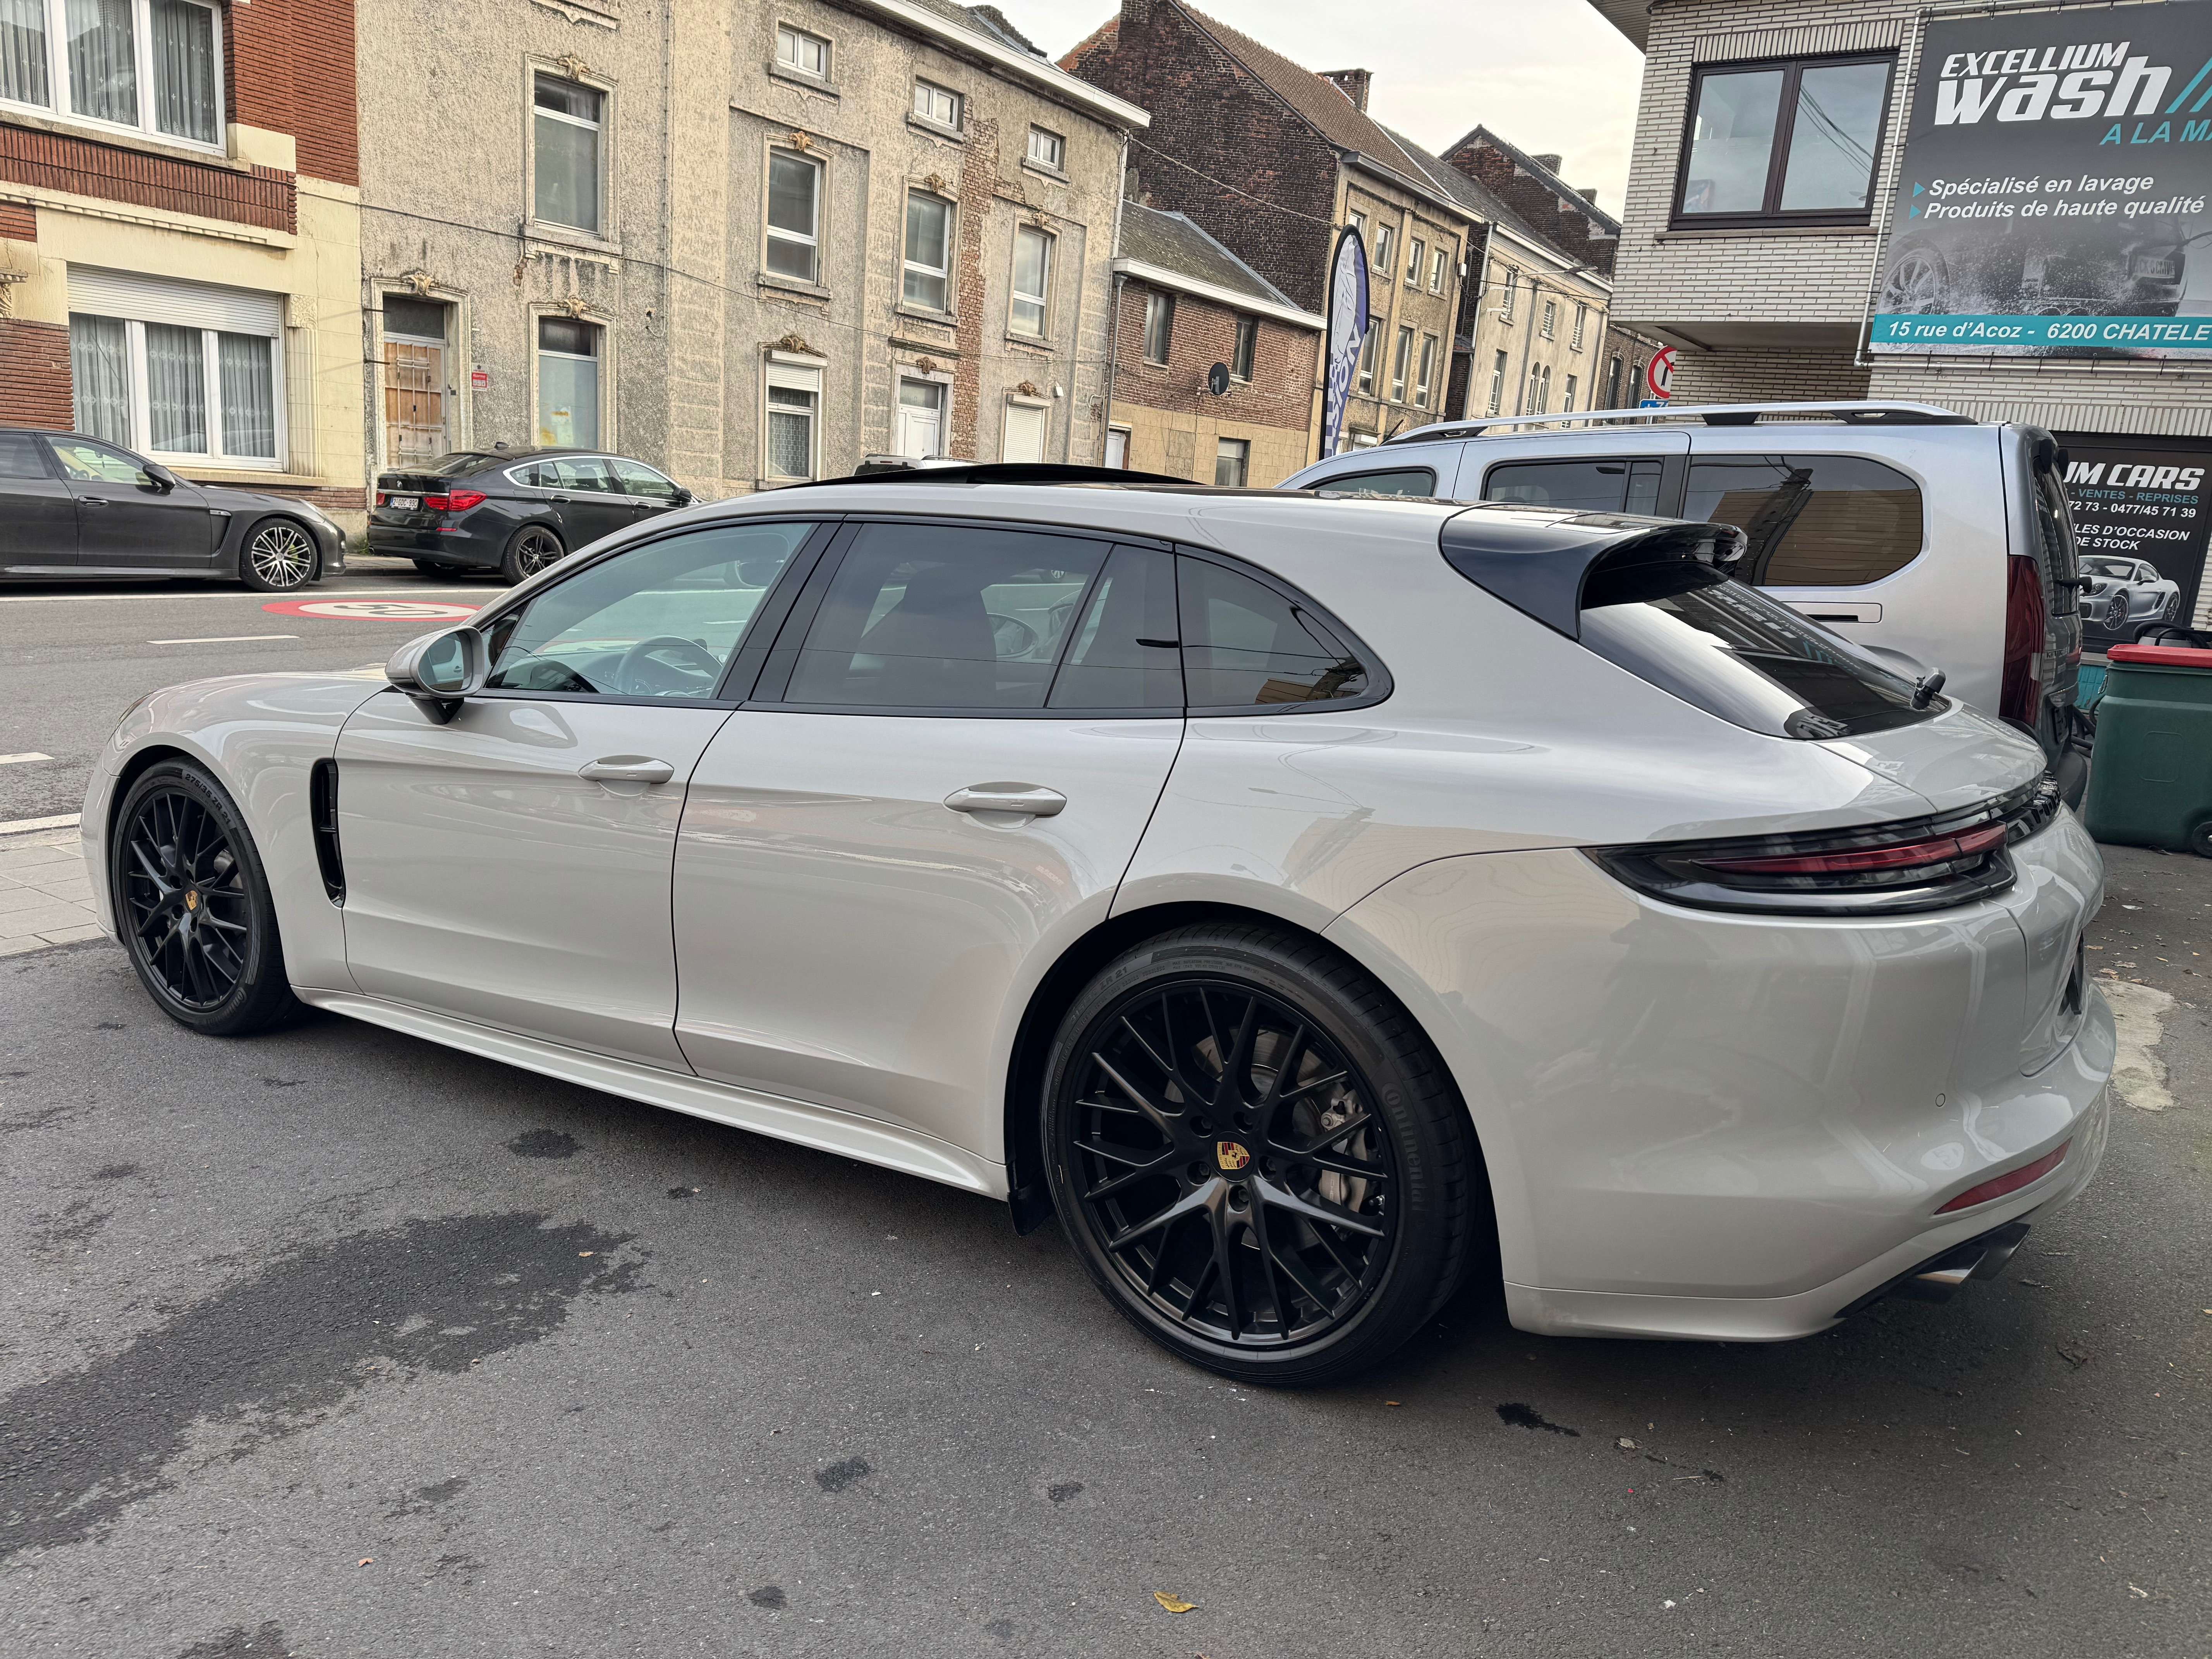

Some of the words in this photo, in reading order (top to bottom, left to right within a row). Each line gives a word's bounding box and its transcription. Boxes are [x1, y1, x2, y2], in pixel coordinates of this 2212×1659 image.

[1941, 41, 2130, 77] EXCELLIUM
[1935, 56, 2172, 125] wash
[2099, 124, 2121, 145] A
[2130, 121, 2170, 144] LA
[1929, 176, 2040, 199] Spécialisé
[2045, 179, 2072, 192] en
[2078, 175, 2154, 194] lavage
[1924, 201, 2015, 218] Produits
[2021, 200, 2048, 216] de
[2053, 199, 2117, 216] haute
[2124, 196, 2206, 218] qualité
[1889, 321, 1911, 336] 15
[1914, 325, 1947, 337] rue
[1953, 322, 2023, 338] d'Acoz
[2047, 323, 2097, 339] 6200
[2107, 464, 2205, 490] CARS
[2079, 489, 2126, 499] VENTES
[2136, 492, 2198, 504] REPRISES
[2085, 501, 2099, 511] 73
[2111, 503, 2159, 515] 0477/45
[2163, 507, 2177, 516] 71
[2181, 508, 2196, 517] 39
[2092, 538, 2141, 550] STOCK
[2102, 525, 2190, 541] D'OCCASION
[185, 774, 212, 798] 275/35
[211, 797, 222, 811] ZR
[1115, 966, 1127, 979] 21
